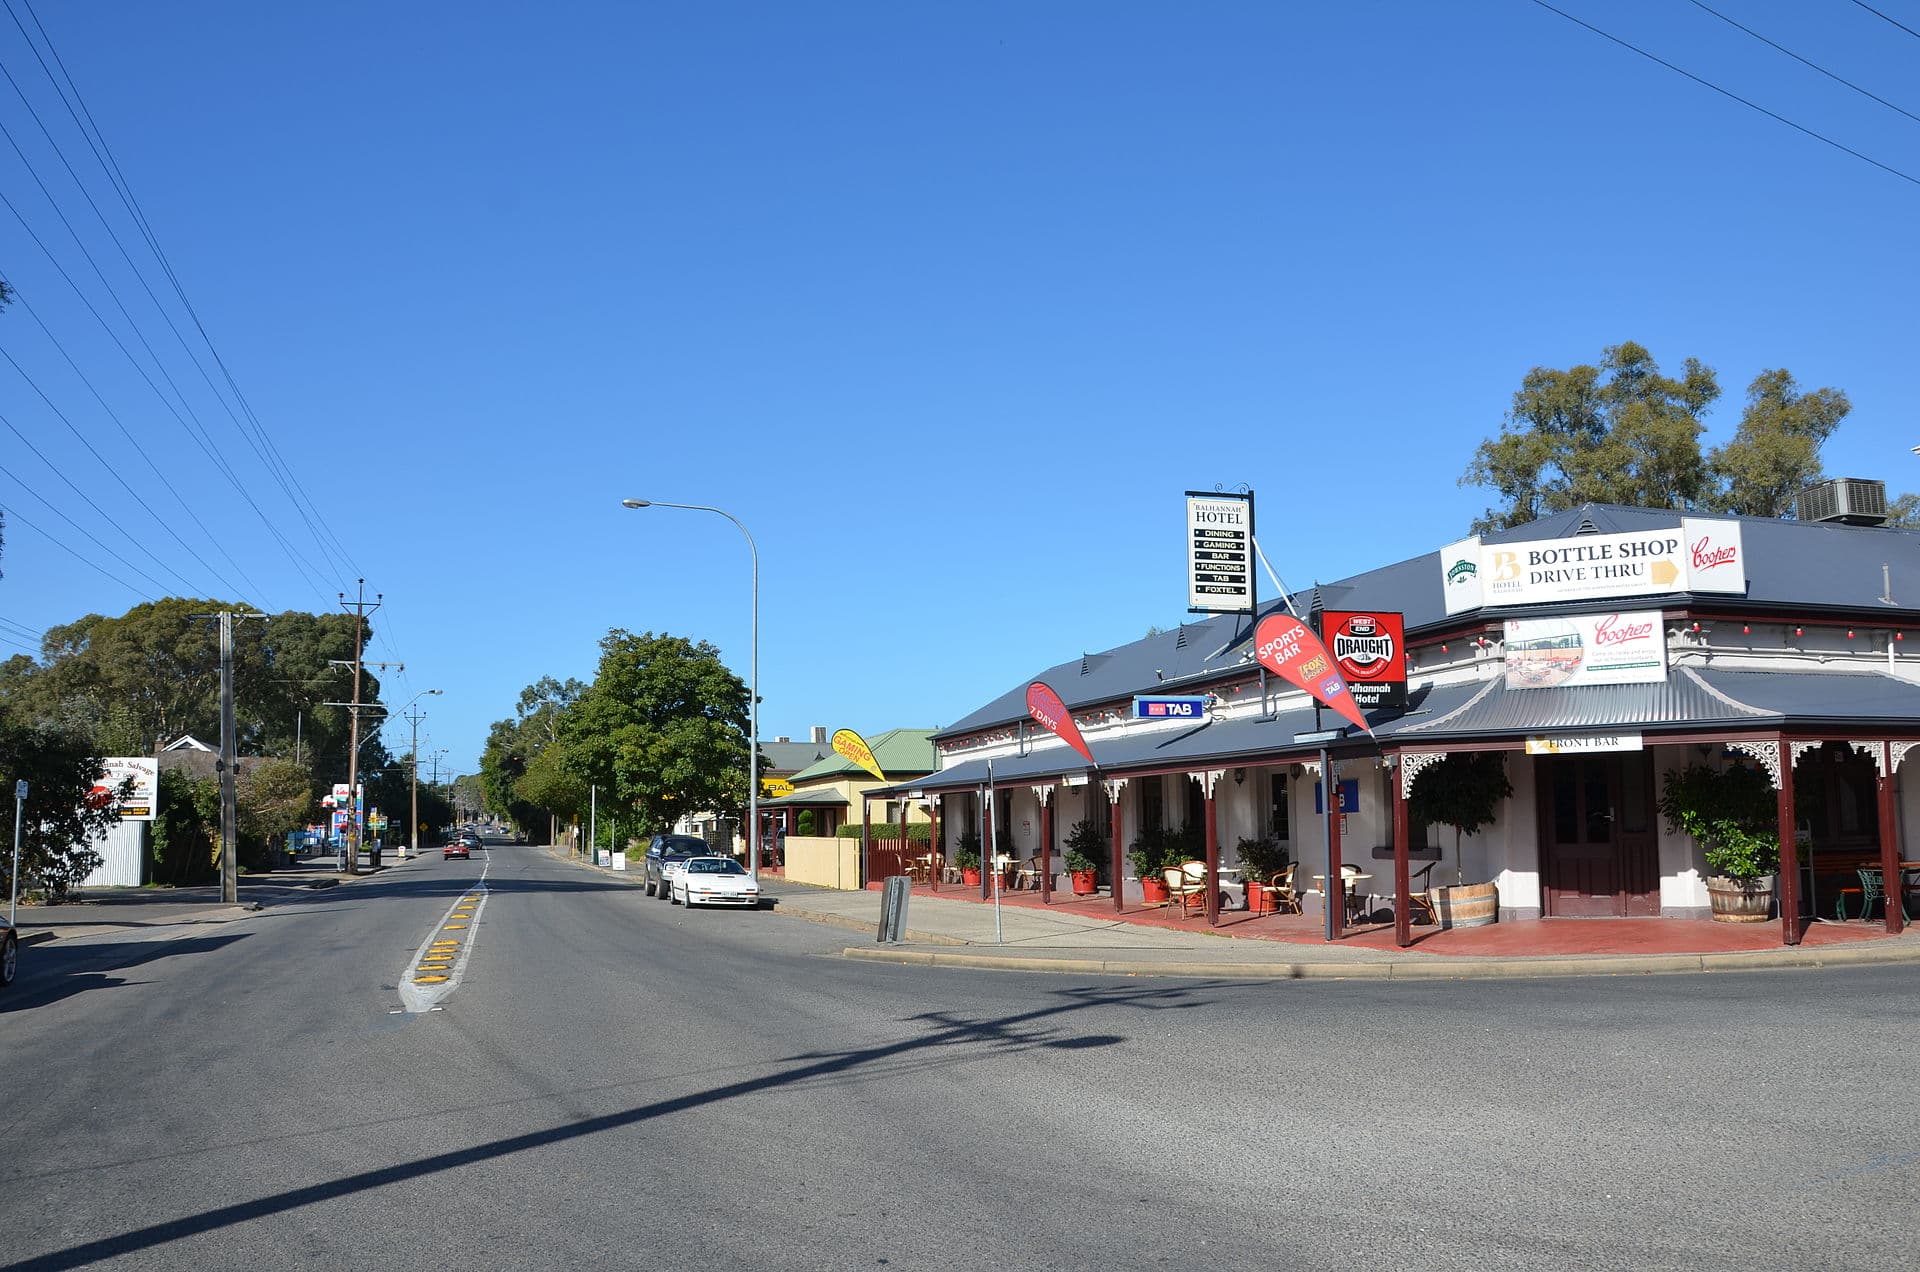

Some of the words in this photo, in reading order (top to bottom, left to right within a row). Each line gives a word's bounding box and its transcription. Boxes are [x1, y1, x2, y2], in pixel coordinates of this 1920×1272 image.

[1195, 504, 1242, 513] BALHANNAH
[1196, 511, 1243, 525] HOTEL
[1204, 530, 1235, 538] DINING
[1202, 541, 1237, 549] GAMING
[1528, 544, 1612, 566] BOTTLE
[1619, 538, 1679, 558] SHOP
[1211, 552, 1230, 560] BAR
[1691, 536, 1736, 573] Coopers
[1200, 563, 1241, 571] FUNCTIONS
[1529, 566, 1587, 584] DRIVE
[1591, 562, 1645, 579] THRU
[1205, 586, 1238, 594] FOXTEL
[1595, 613, 1653, 648] Coopers
[1258, 625, 1305, 659] SPORTS
[1336, 638, 1391, 657] DRAUGHT
[1274, 643, 1302, 665] BAR
[1303, 656, 1322, 672] FOX
[1325, 682, 1341, 695] TAB
[1349, 683, 1391, 693] alhannah
[1355, 694, 1380, 703] Hotel
[1166, 703, 1193, 716] TAB
[1030, 705, 1036, 715] 7
[1036, 710, 1058, 730] DAYS
[833, 735, 871, 761] GAMING
[1549, 737, 1589, 748] FRONT
[1594, 736, 1620, 747] BAR
[839, 747, 860, 763] OPEN
[127, 761, 155, 776] Salvage
